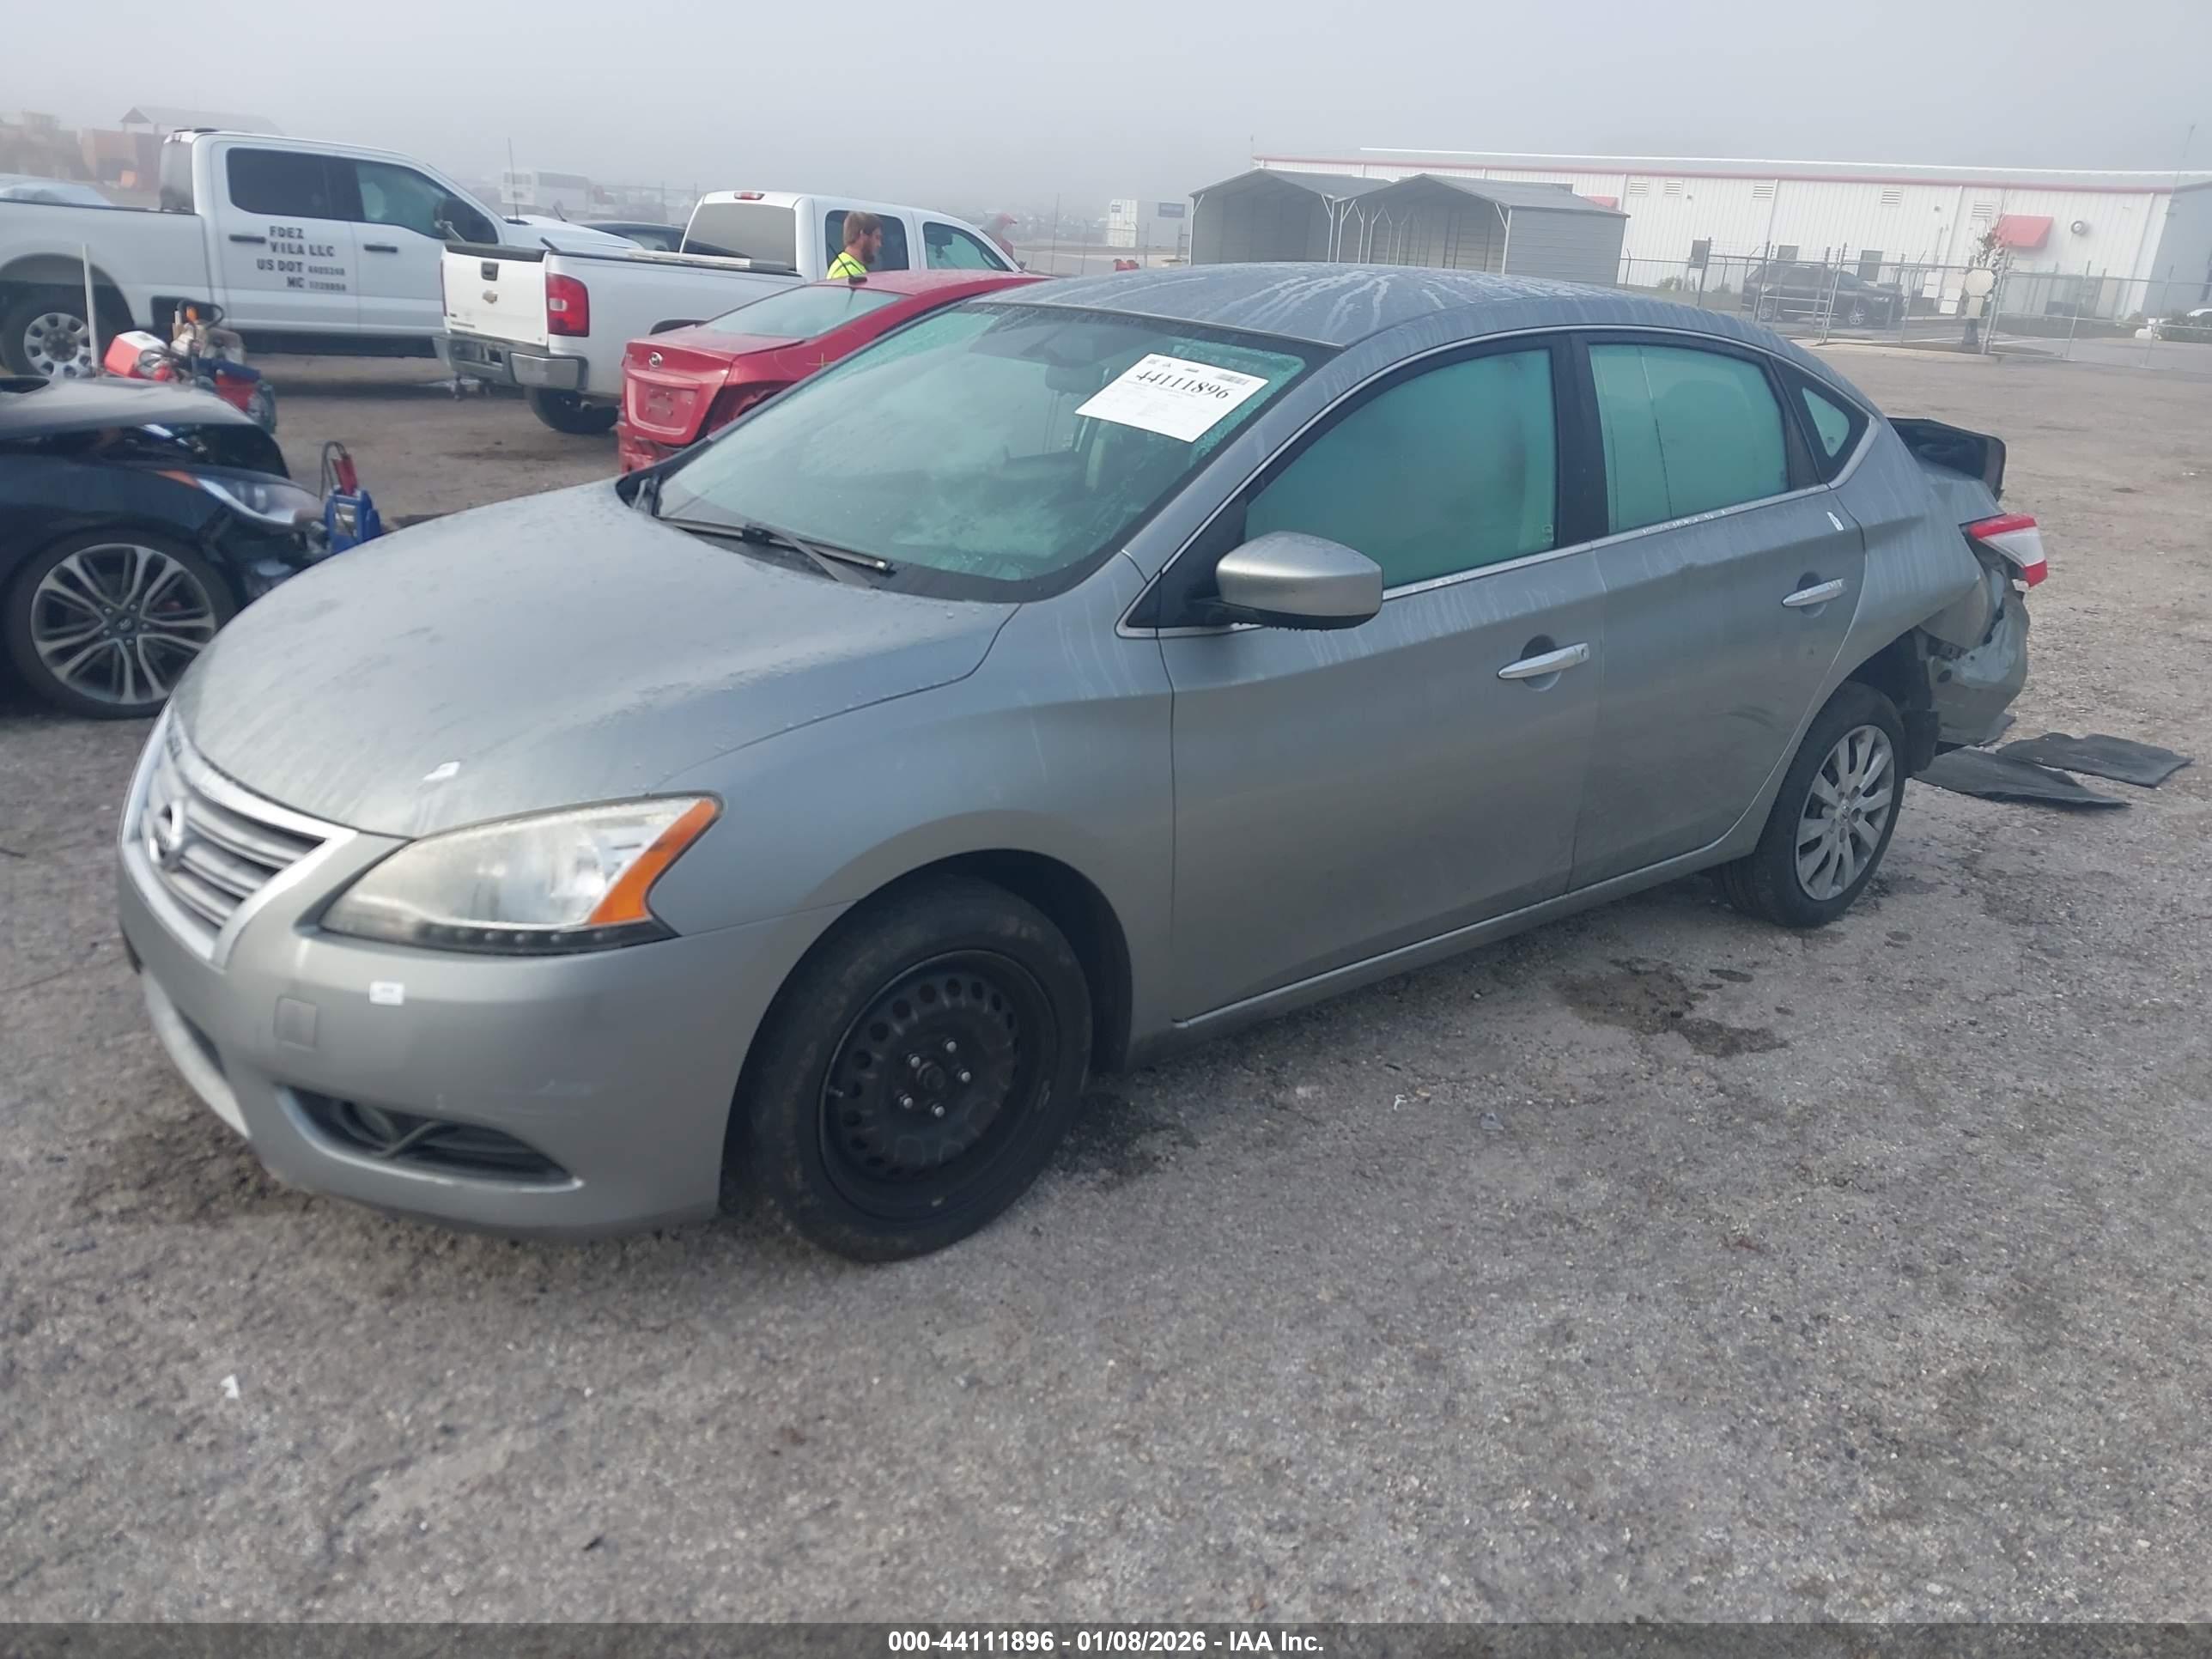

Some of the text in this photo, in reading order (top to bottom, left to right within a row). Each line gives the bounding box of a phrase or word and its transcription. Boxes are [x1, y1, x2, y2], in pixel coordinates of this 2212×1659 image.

[270, 226, 304, 239] FDEZ
[270, 242, 335, 257] VILA LLC
[257, 259, 274, 270] US
[277, 260, 303, 272] DOT
[287, 276, 305, 289] MC
[1136, 370, 1231, 399] 44111896
